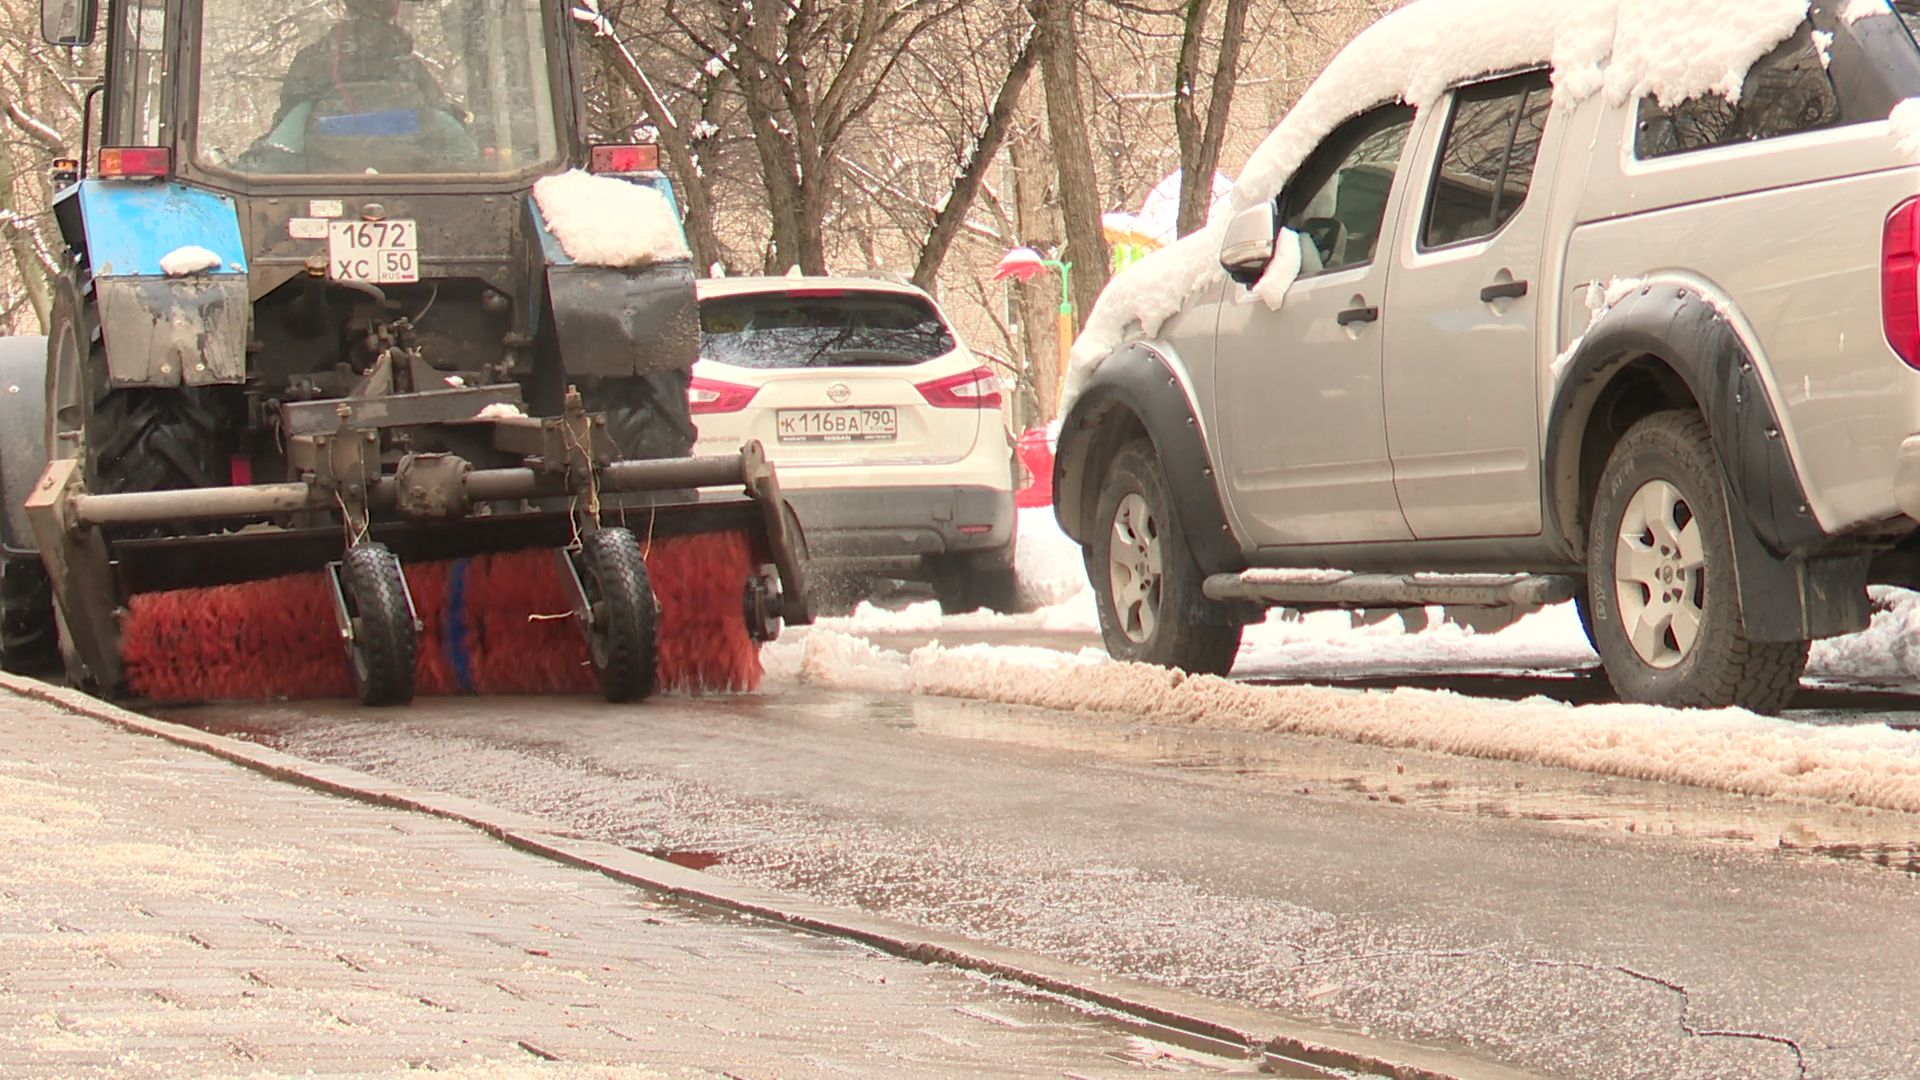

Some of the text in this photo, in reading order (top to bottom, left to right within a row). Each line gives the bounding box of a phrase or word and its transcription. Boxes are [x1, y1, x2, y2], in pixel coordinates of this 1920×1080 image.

[343, 223, 405, 248] 1672
[387, 253, 411, 271] 50
[382, 272, 400, 280] RUS
[863, 410, 890, 426] 790
